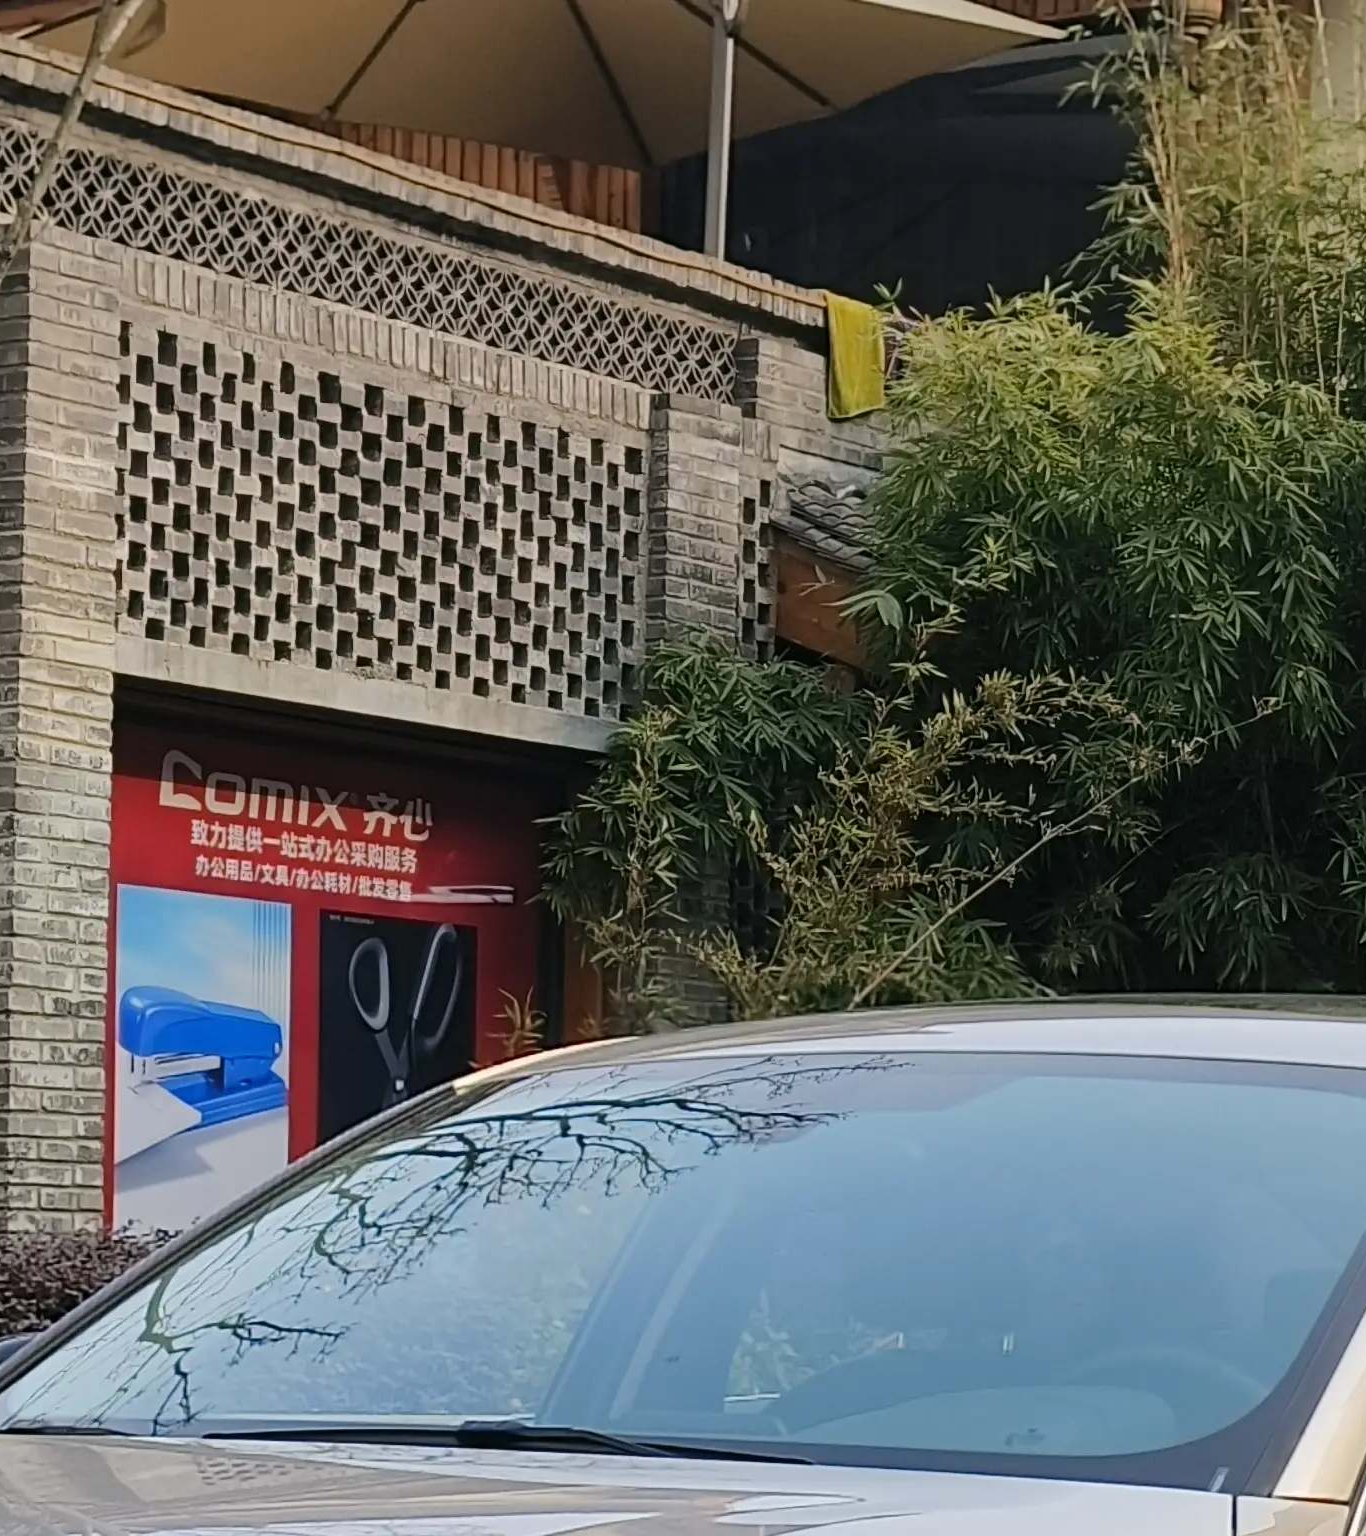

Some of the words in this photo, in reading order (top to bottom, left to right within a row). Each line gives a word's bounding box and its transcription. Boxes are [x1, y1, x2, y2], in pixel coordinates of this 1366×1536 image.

[363, 791, 433, 842] 齐心
[190, 818, 418, 874] 致力提供一站式办公采购服务
